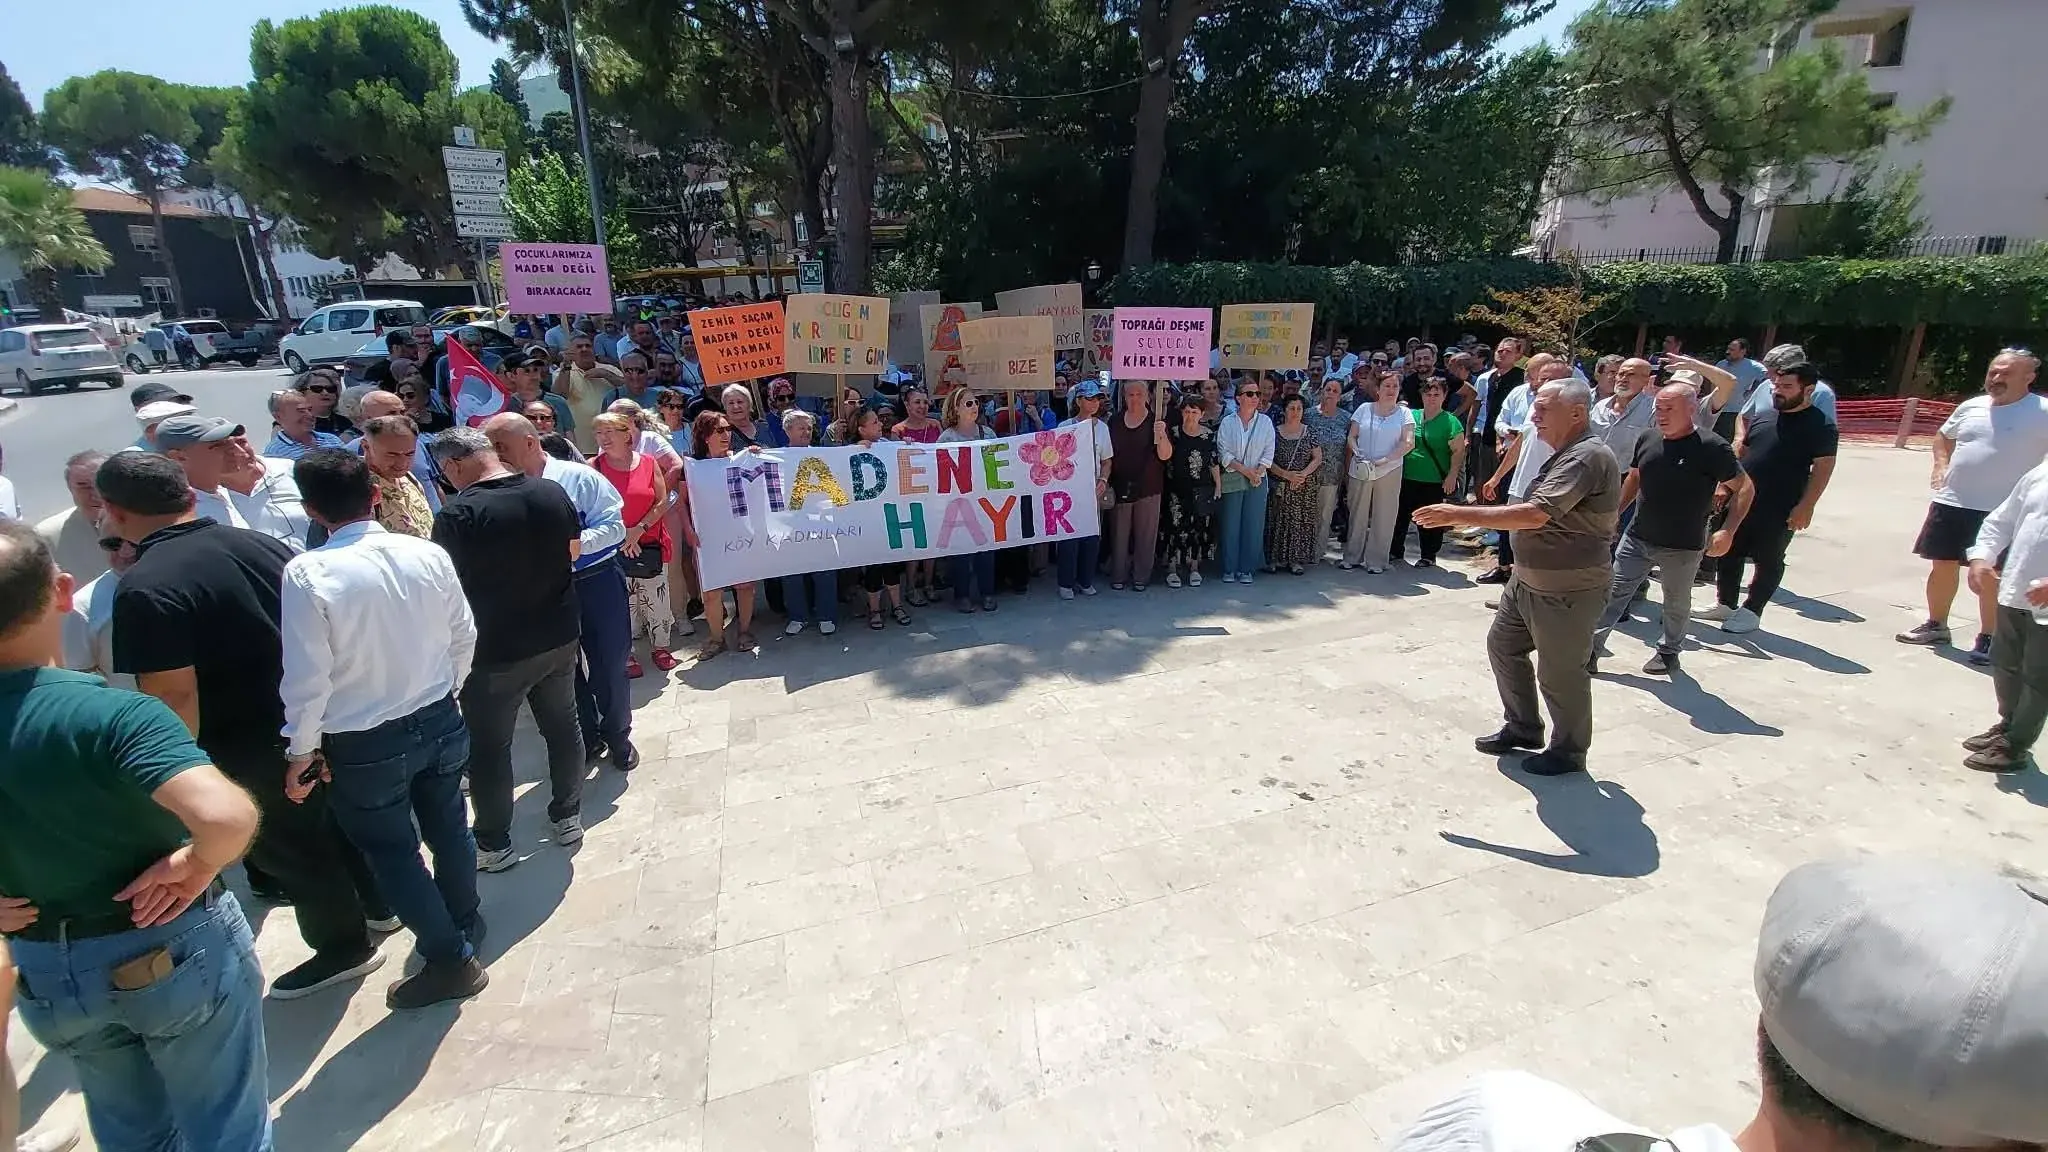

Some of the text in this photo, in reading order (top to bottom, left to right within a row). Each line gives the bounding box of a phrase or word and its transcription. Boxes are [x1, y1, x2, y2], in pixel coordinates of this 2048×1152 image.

[514, 249, 593, 260] ÇOCUKLARIMIZA
[514, 262, 597, 274] MADEN DEĞİL
[526, 286, 592, 296] BIRAKACAĞIZ
[700, 311, 774, 329] ZEHİR SAÇAN
[1120, 317, 1205, 333] TOPRAĞI DEŞME
[702, 325, 782, 345] MADEN DEĞİL
[718, 341, 772, 357] YAŞAMAK
[1123, 353, 1195, 368] KİRLETME
[725, 443, 1015, 518] MADENE
[884, 490, 1075, 550] HAYIR
[724, 536, 755, 553] KÖY
